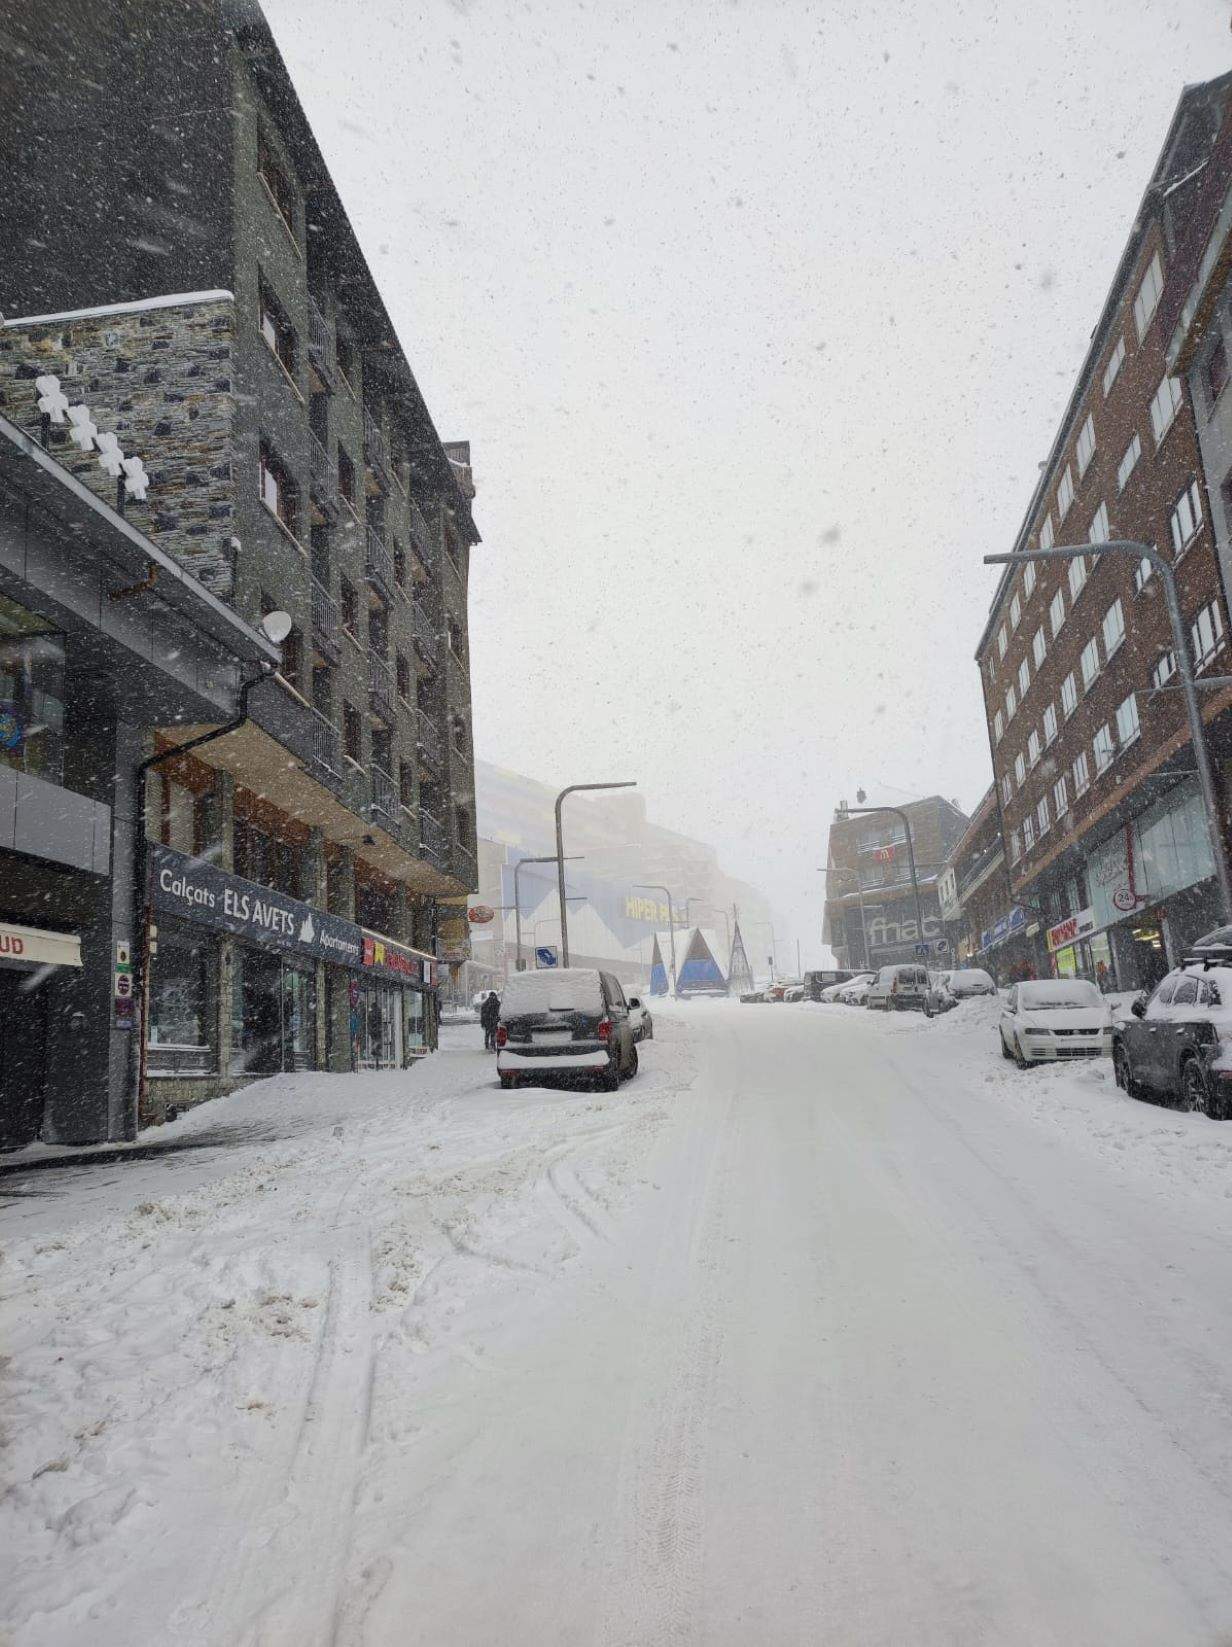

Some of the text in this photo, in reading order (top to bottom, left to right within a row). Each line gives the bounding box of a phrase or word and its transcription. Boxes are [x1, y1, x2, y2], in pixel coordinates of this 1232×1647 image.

[160, 869, 294, 935] Calçats ELS AVETS
[869, 917, 941, 945] fnac
